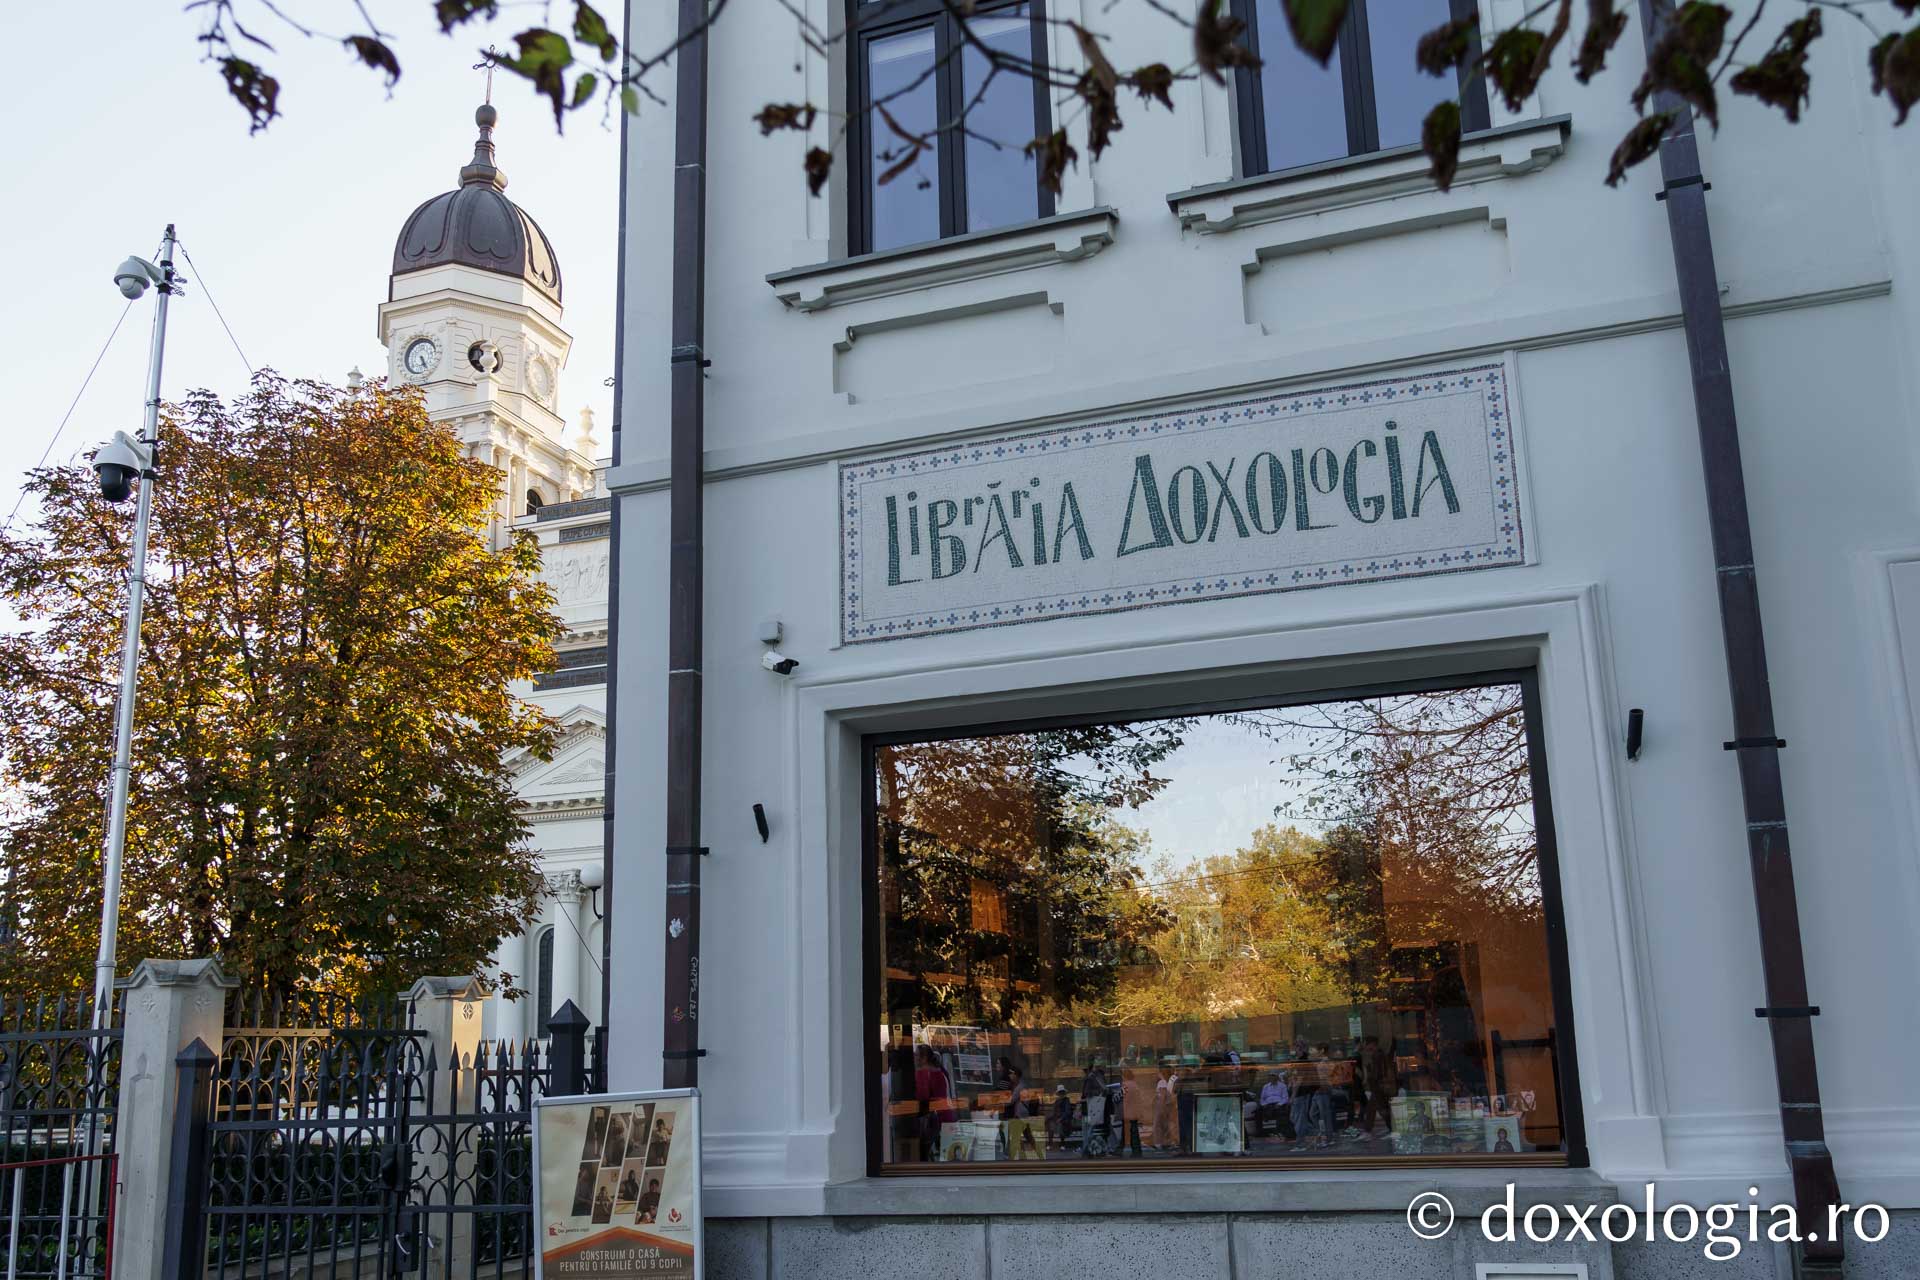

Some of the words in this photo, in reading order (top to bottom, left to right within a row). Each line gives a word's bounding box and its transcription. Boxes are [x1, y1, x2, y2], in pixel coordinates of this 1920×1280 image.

[580, 1249, 626, 1261] CONSTRUIM
[629, 1249, 636, 1260] O
[638, 1246, 661, 1259] CASĂ
[560, 1260, 591, 1272] PENTRU
[592, 1260, 598, 1272] O
[600, 1258, 632, 1271] FAMILIE
[635, 1258, 648, 1270] CU
[650, 1257, 656, 1269] 9
[659, 1256, 683, 1269] COPII
